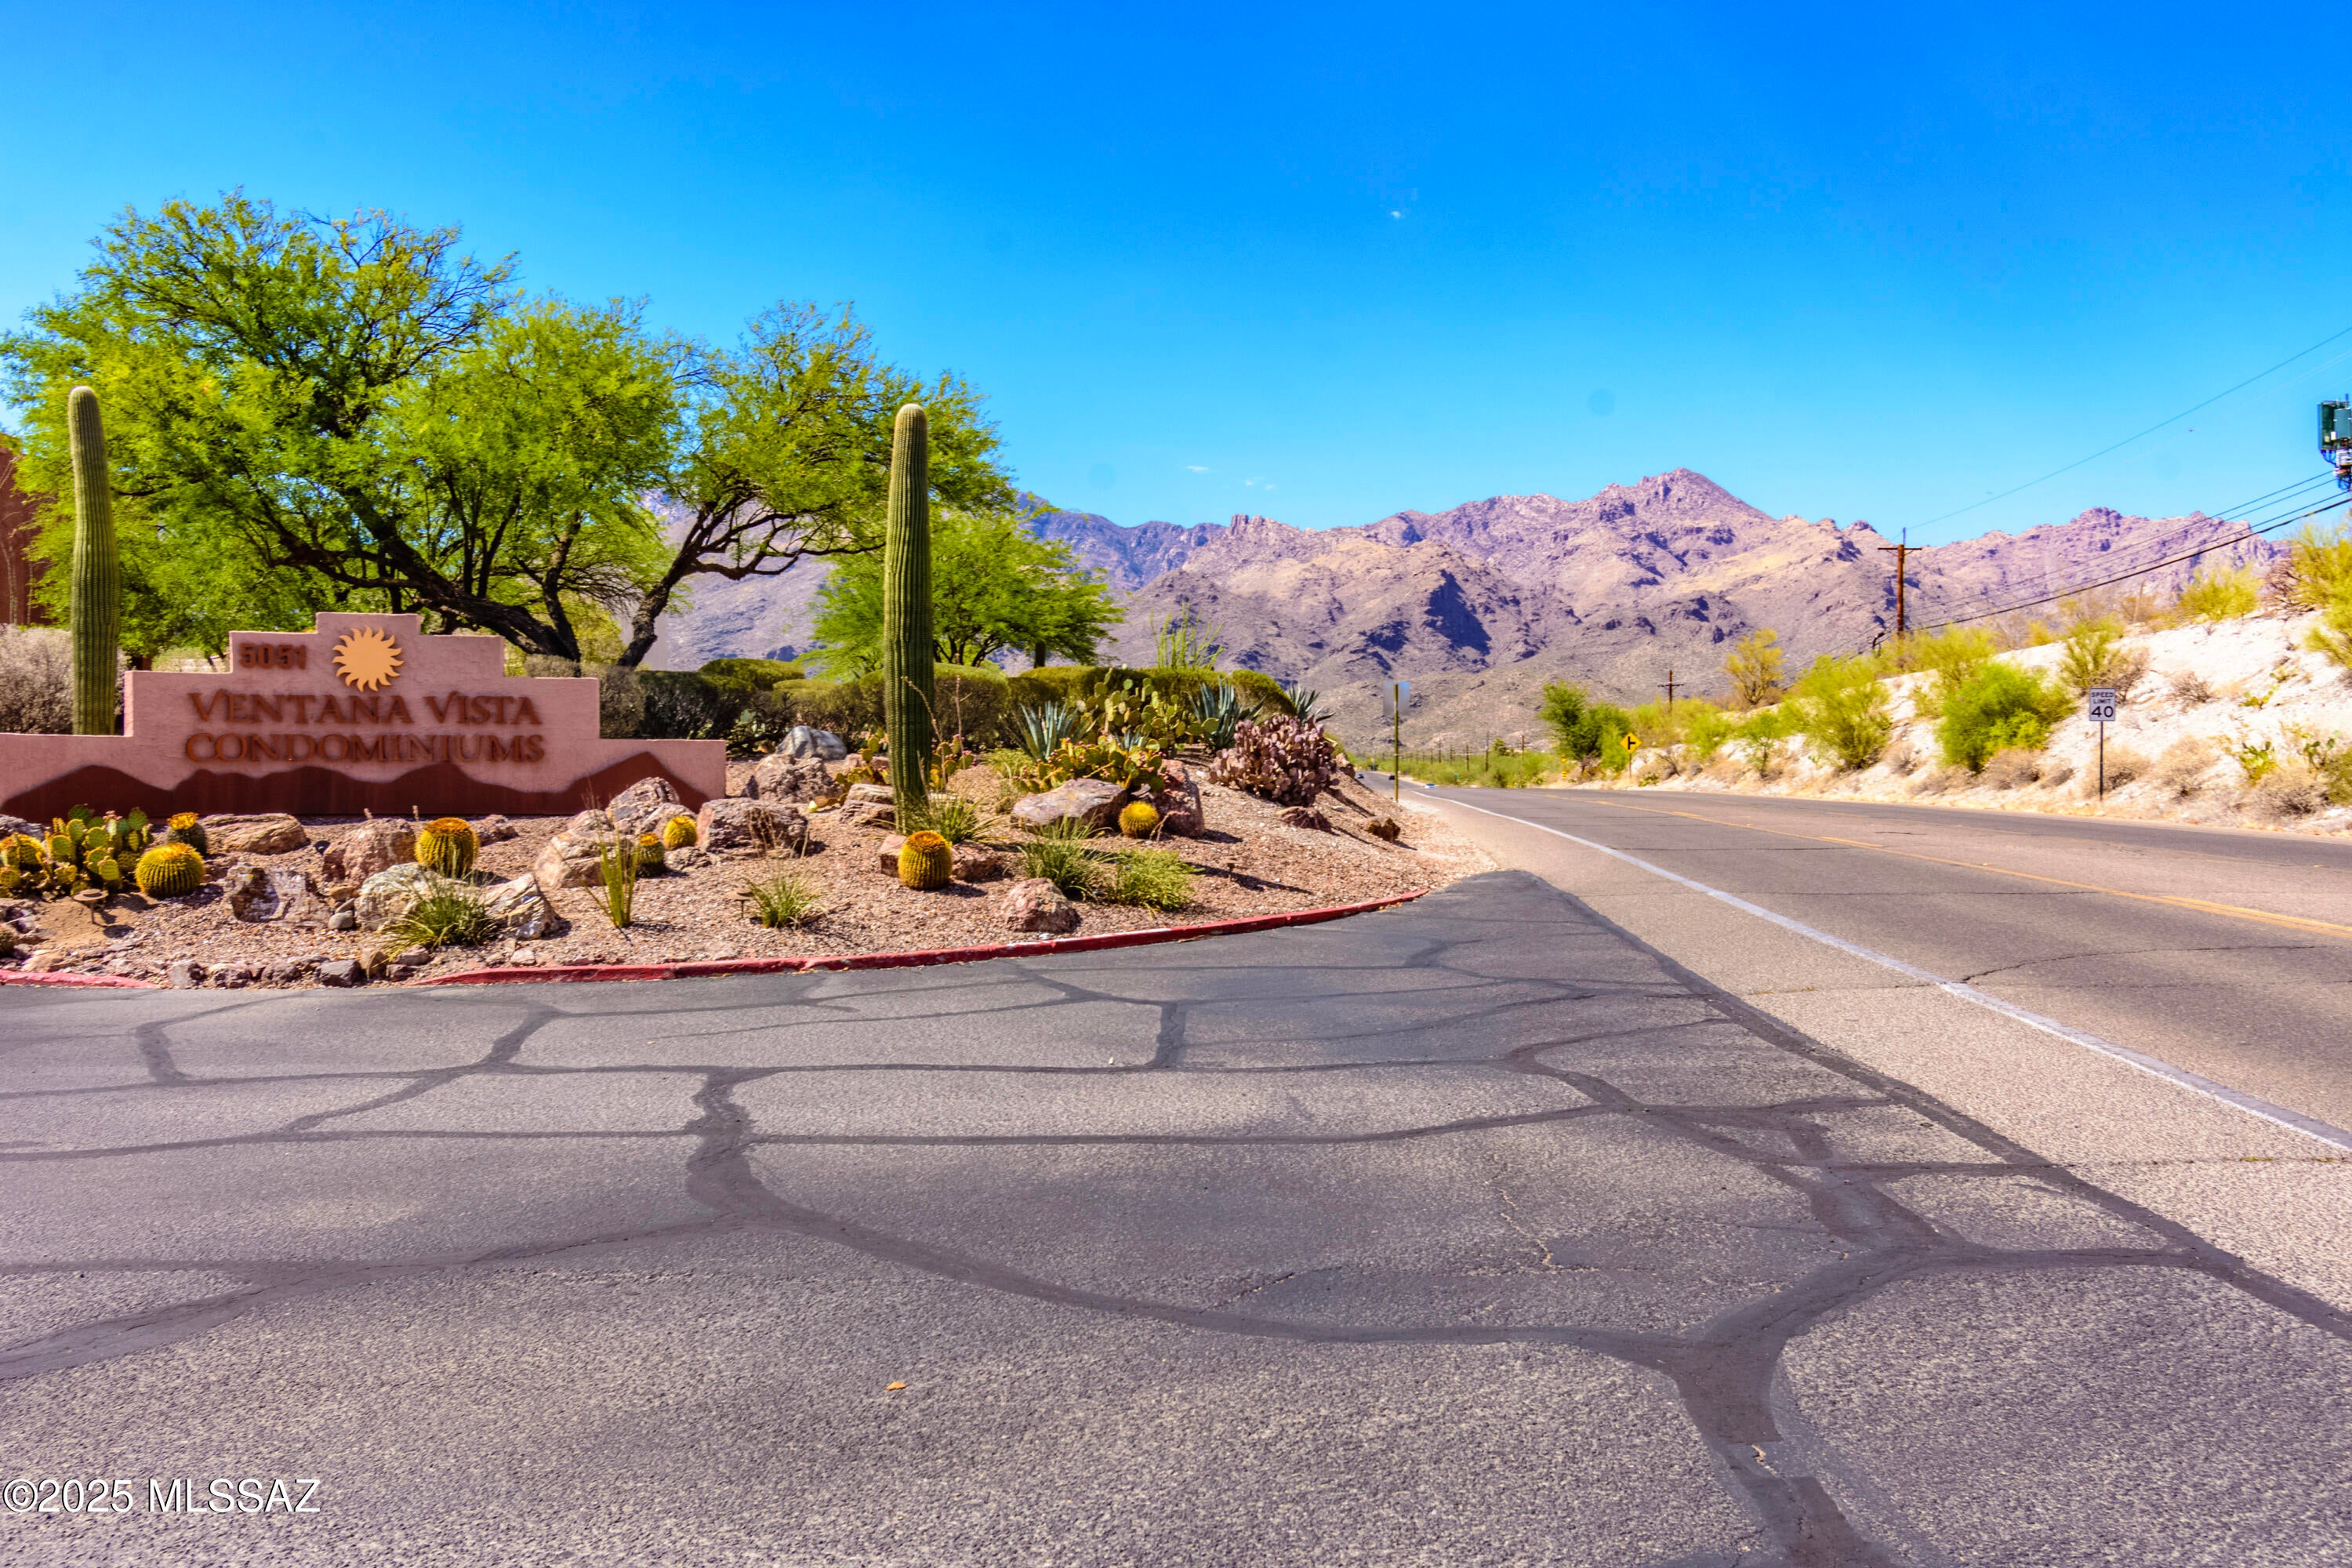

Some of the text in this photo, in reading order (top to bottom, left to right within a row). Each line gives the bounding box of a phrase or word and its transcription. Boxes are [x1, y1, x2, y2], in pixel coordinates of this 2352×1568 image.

[239, 643, 307, 670] 5051
[187, 688, 543, 724] VENTANA VISTA
[2091, 706, 2114, 717] 40
[185, 732, 545, 763] CONDOMINIUMS
